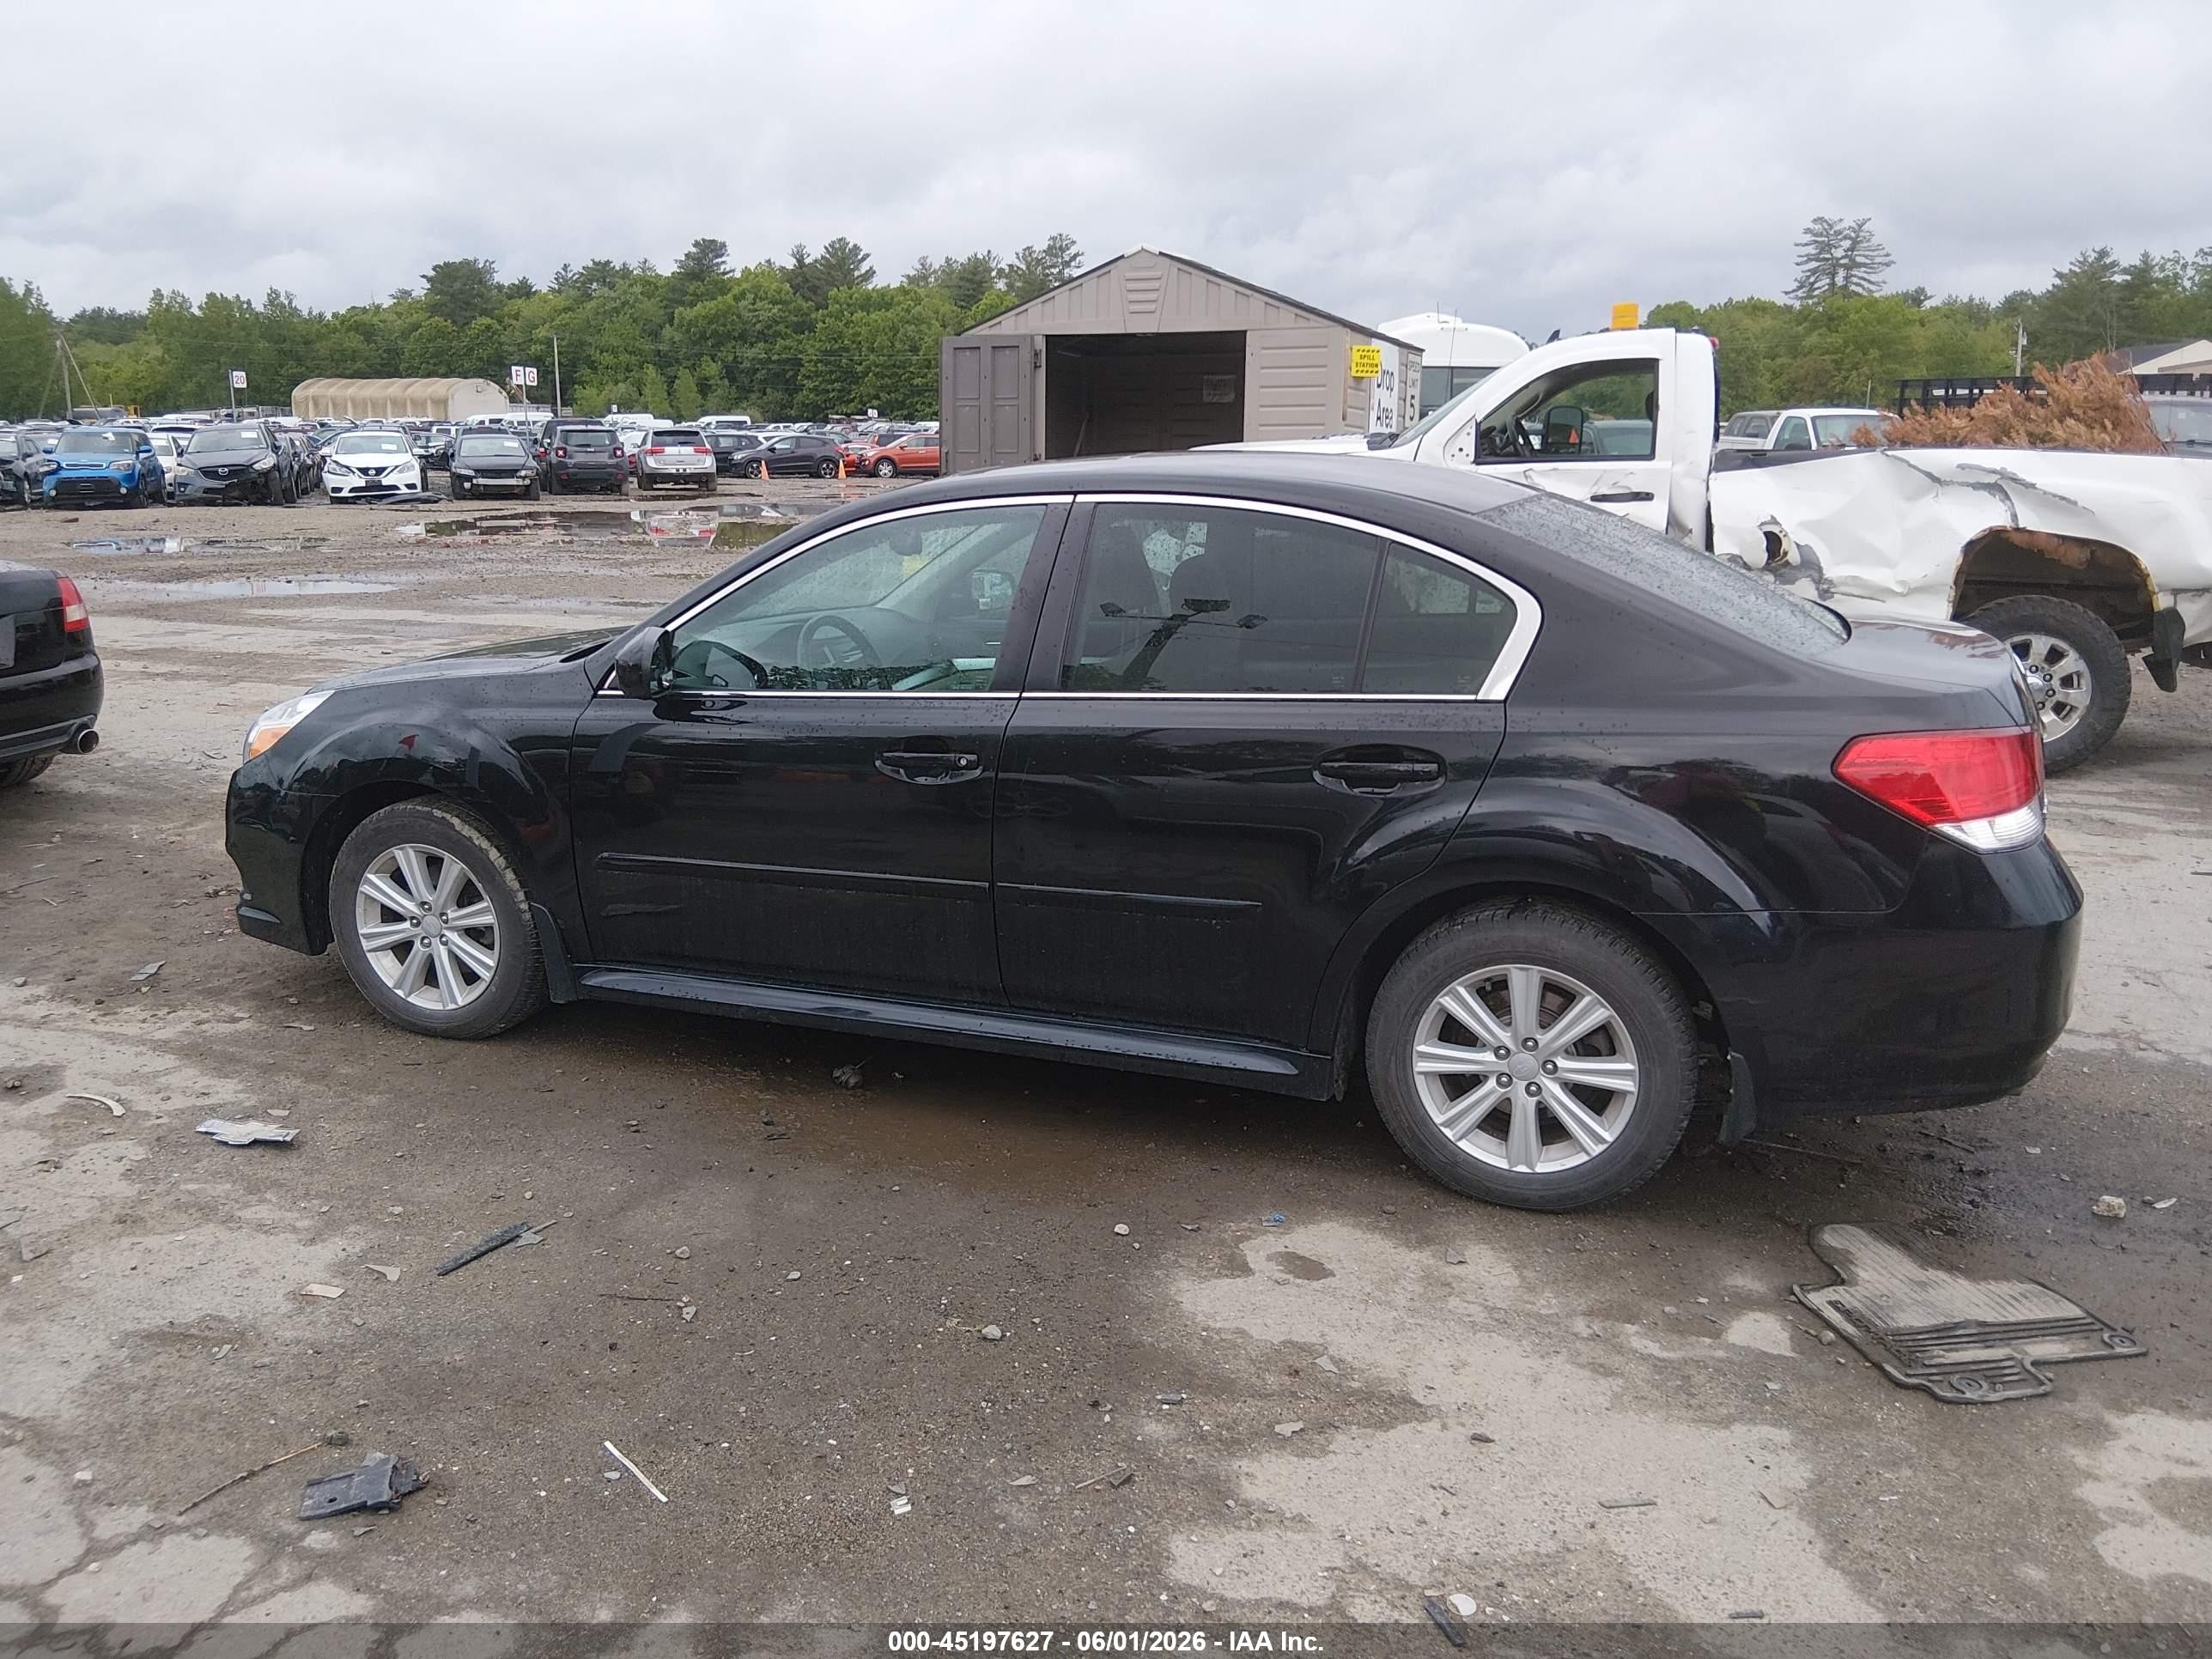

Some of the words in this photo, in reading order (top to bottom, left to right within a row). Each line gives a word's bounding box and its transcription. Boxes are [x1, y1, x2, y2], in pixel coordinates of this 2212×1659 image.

[234, 374, 246, 385] 20
[515, 369, 520, 382] F
[528, 370, 535, 383] G
[1376, 398, 1394, 428] Area
[1409, 394, 1416, 422] 5
